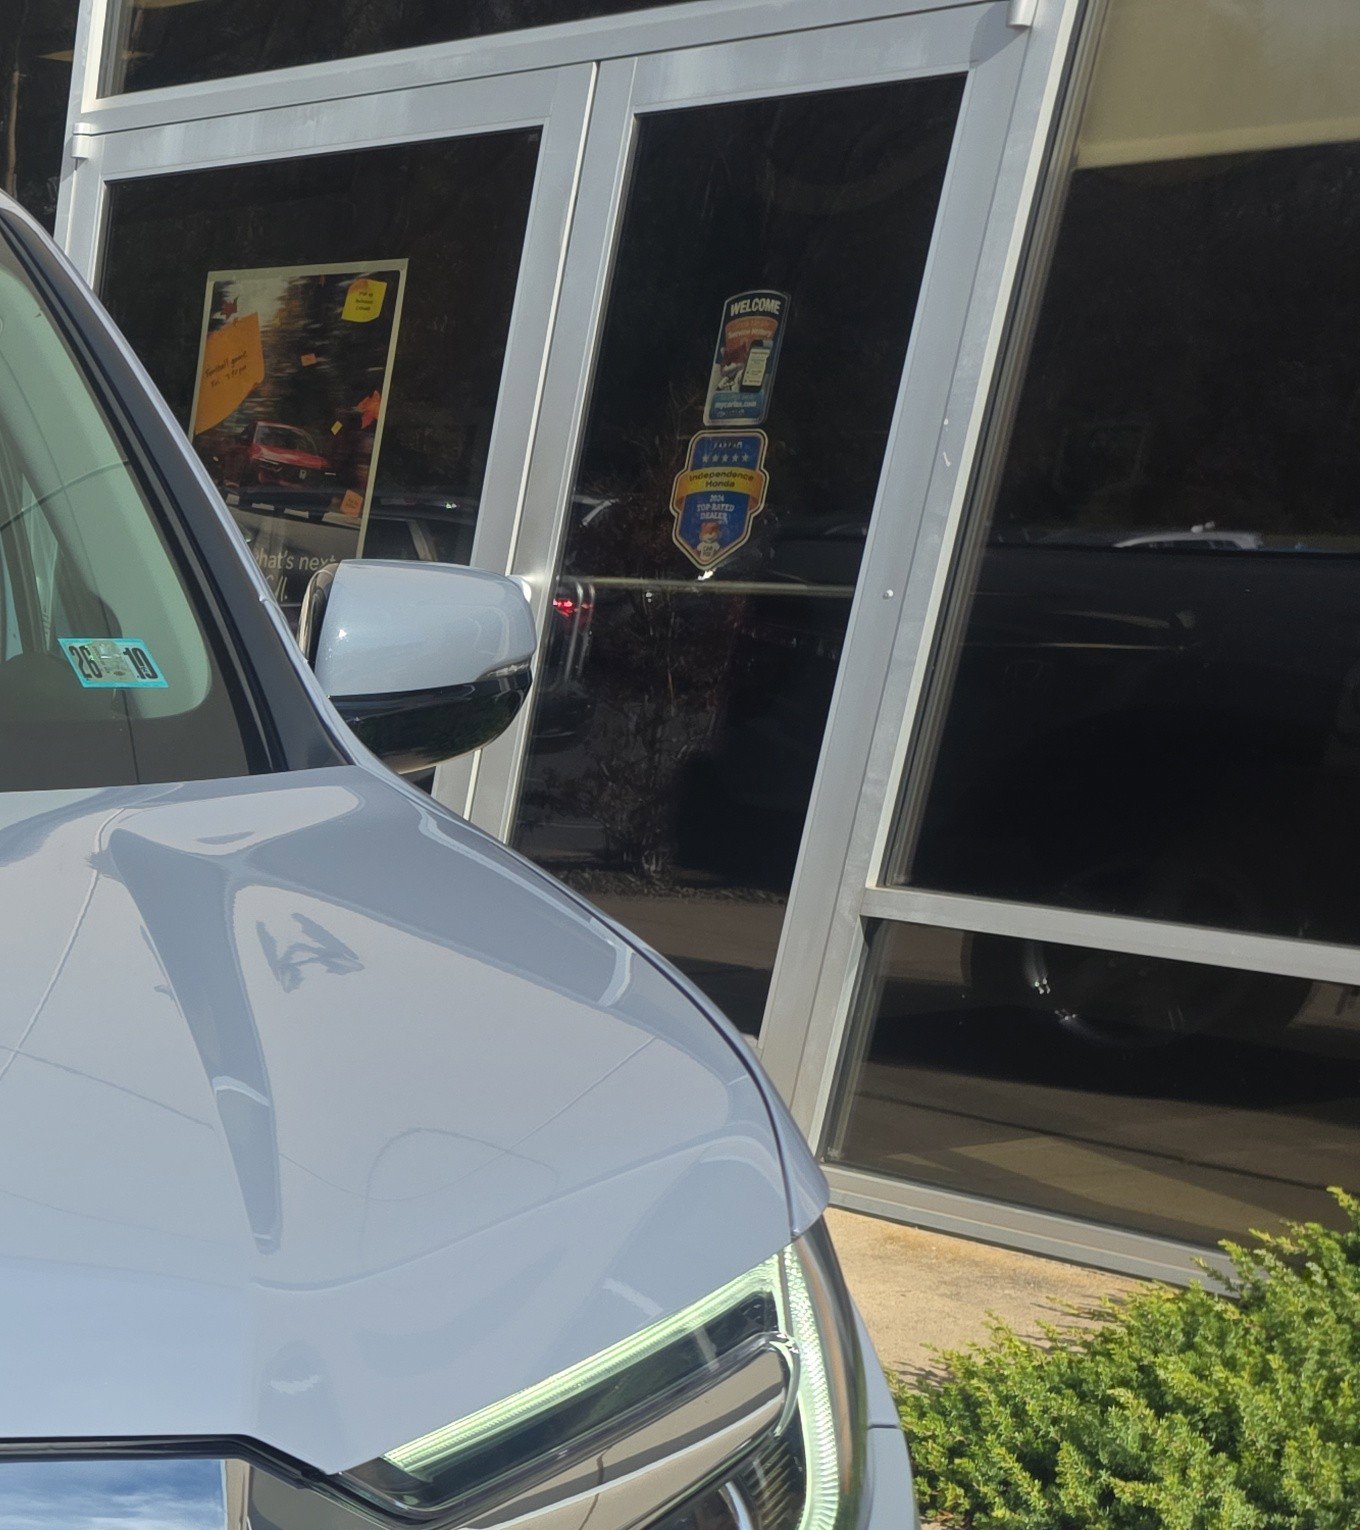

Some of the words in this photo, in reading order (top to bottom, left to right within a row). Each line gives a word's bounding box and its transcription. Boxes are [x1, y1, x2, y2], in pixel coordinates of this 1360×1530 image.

[730, 298, 781, 316] WELCOME
[689, 470, 754, 482] Independence
[704, 480, 736, 488] Honda
[255, 547, 295, 570] hat's
[68, 645, 103, 678] 26
